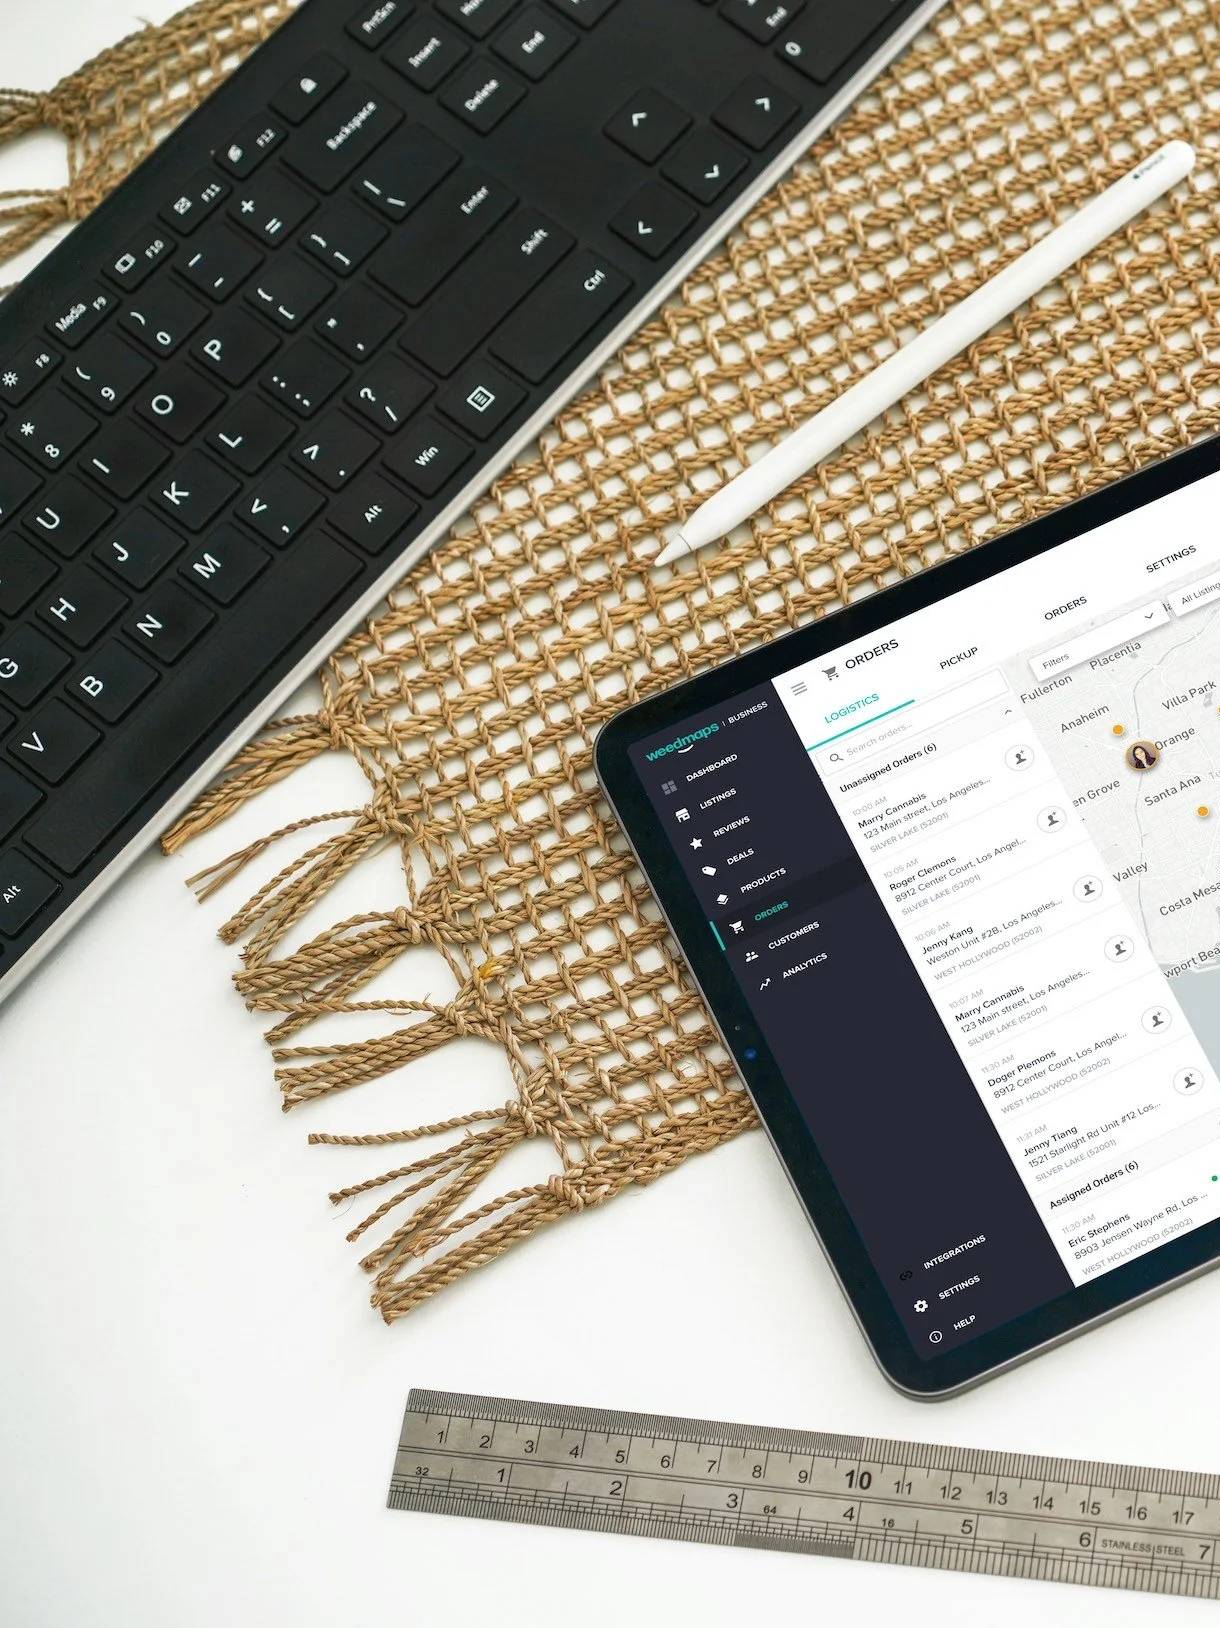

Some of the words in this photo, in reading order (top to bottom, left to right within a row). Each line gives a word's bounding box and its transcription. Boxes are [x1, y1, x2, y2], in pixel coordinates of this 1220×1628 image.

[765, 6, 787, 27] End
[408, 37, 441, 68] Insert
[521, 30, 545, 54] End
[464, 79, 499, 112] Delete
[256, 128, 275, 148] F12
[326, 101, 377, 150] Backspace
[201, 183, 221, 203] F11
[460, 186, 489, 214] Enter
[145, 239, 164, 259] F10
[520, 228, 548, 255] Shift
[583, 269, 606, 291] Ctrl
[92, 296, 107, 311] F9
[55, 303, 87, 332] Media
[35, 353, 50, 368] F8
[203, 339, 222, 361] P
[100, 386, 116, 402] 9
[151, 394, 174, 415] O
[44, 443, 60, 458] 8
[218, 432, 243, 448] L
[414, 446, 439, 466] Win
[162, 481, 190, 506] K
[35, 507, 61, 530] U
[364, 504, 383, 523] Alt
[112, 541, 129, 562] J
[1145, 545, 1197, 573] SETTINGS
[192, 552, 222, 579] M
[49, 597, 77, 622] H
[1044, 595, 1087, 621] ORDERS
[1181, 594, 1193, 605] All
[136, 613, 163, 638] N
[845, 638, 899, 669] ORDERS
[939, 646, 978, 670] PICKUP
[1042, 653, 1070, 670] Filters
[1089, 642, 1142, 670] Placentia
[79, 675, 104, 698] B
[1019, 675, 1073, 704] Fullerton
[1161, 694, 1189, 710] Villa
[1188, 680, 1217, 698] Park
[824, 693, 880, 724] LOGISTICS
[1061, 705, 1110, 733] Anaheim
[21, 731, 45, 753] V
[645, 722, 719, 761] weedmaps
[727, 700, 768, 724] BUSINESS
[1153, 727, 1196, 753] Orange
[685, 753, 738, 782] DASHBOARD
[839, 763, 892, 793] Unassigned
[892, 750, 923, 768] Orders
[923, 742, 937, 755] (6)
[699, 787, 737, 810] LISTINGS
[874, 795, 888, 806] AM
[1144, 786, 1178, 806] Santa
[1179, 775, 1202, 791] Ana
[857, 813, 883, 829] Marry
[885, 793, 927, 816] Cannabis
[863, 827, 880, 839] 123
[879, 818, 902, 832] Main
[930, 796, 948, 808] Los
[712, 815, 750, 837] REVIEWS
[869, 835, 898, 853] SILVER
[897, 825, 919, 840] LAKE
[726, 847, 754, 865] DEALS
[740, 867, 786, 893] PRODUCTS
[888, 874, 916, 891] Roger
[917, 856, 957, 878] Clemons
[894, 887, 917, 903] 8912
[917, 873, 947, 892] Center
[975, 852, 993, 864] Los
[1112, 861, 1148, 882] Valley
[2, 885, 21, 904] Alt
[1159, 896, 1192, 916] Costa
[754, 900, 789, 921] ORDERS
[768, 921, 820, 950] CUSTOMERS
[922, 937, 948, 955] Jenny
[948, 926, 974, 941] Kang
[782, 952, 828, 978] ANALYTICS
[933, 965, 957, 980] WEST
[957, 940, 1011, 969] HOLLYWOOD
[1050, 1182, 1092, 1210] Assigned
[1092, 1169, 1124, 1188] Orders
[1124, 1160, 1139, 1174] (6)
[1067, 1235, 1087, 1248] Eric
[1086, 1213, 1131, 1238] Stephens
[923, 1234, 986, 1270] INTEGRATIONS
[938, 1274, 980, 1300] SETTINGS
[953, 1314, 976, 1330] HELP
[480, 1434, 492, 1449] 2
[524, 1439, 535, 1454] 3
[568, 1444, 581, 1459] 4
[615, 1449, 626, 1464] 5
[660, 1454, 671, 1469] 6
[707, 1460, 718, 1475] 7
[752, 1465, 763, 1480] 8
[797, 1470, 808, 1485] 9
[844, 1470, 872, 1490] 10
[609, 1481, 622, 1496] 2
[726, 1494, 738, 1509] 3
[842, 1507, 855, 1522] 4
[1079, 1532, 1091, 1548] 6
[1101, 1539, 1152, 1555] STAINLESS
[1156, 1545, 1186, 1557] STEEL
